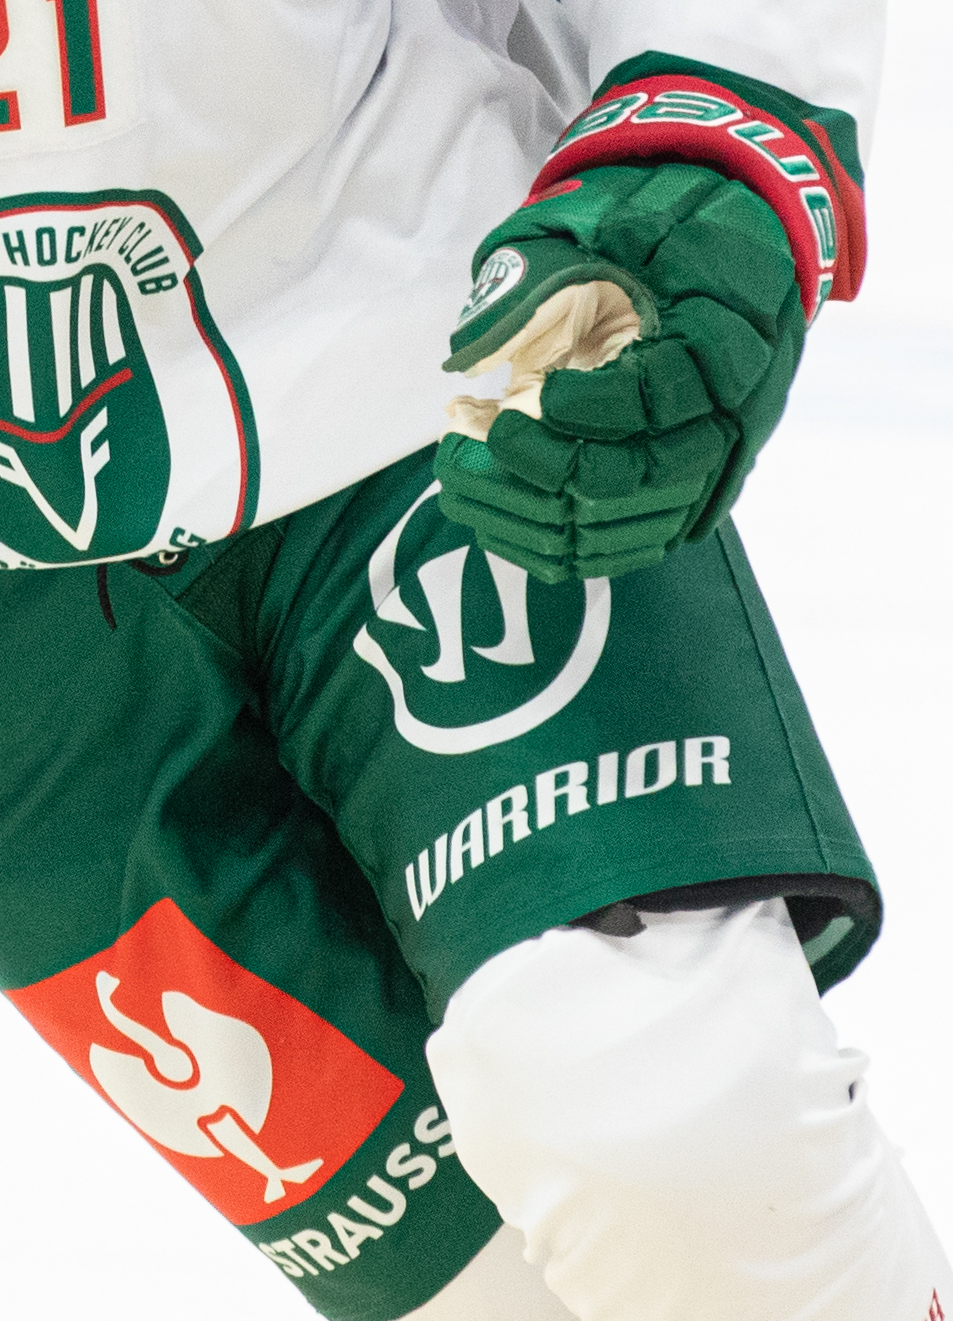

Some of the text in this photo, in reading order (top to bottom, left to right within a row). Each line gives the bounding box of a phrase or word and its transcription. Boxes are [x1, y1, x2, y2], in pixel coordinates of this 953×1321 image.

[2, 216, 133, 266] HOCKEY
[117, 221, 179, 295] CLUB
[404, 735, 732, 922] WARRIOR
